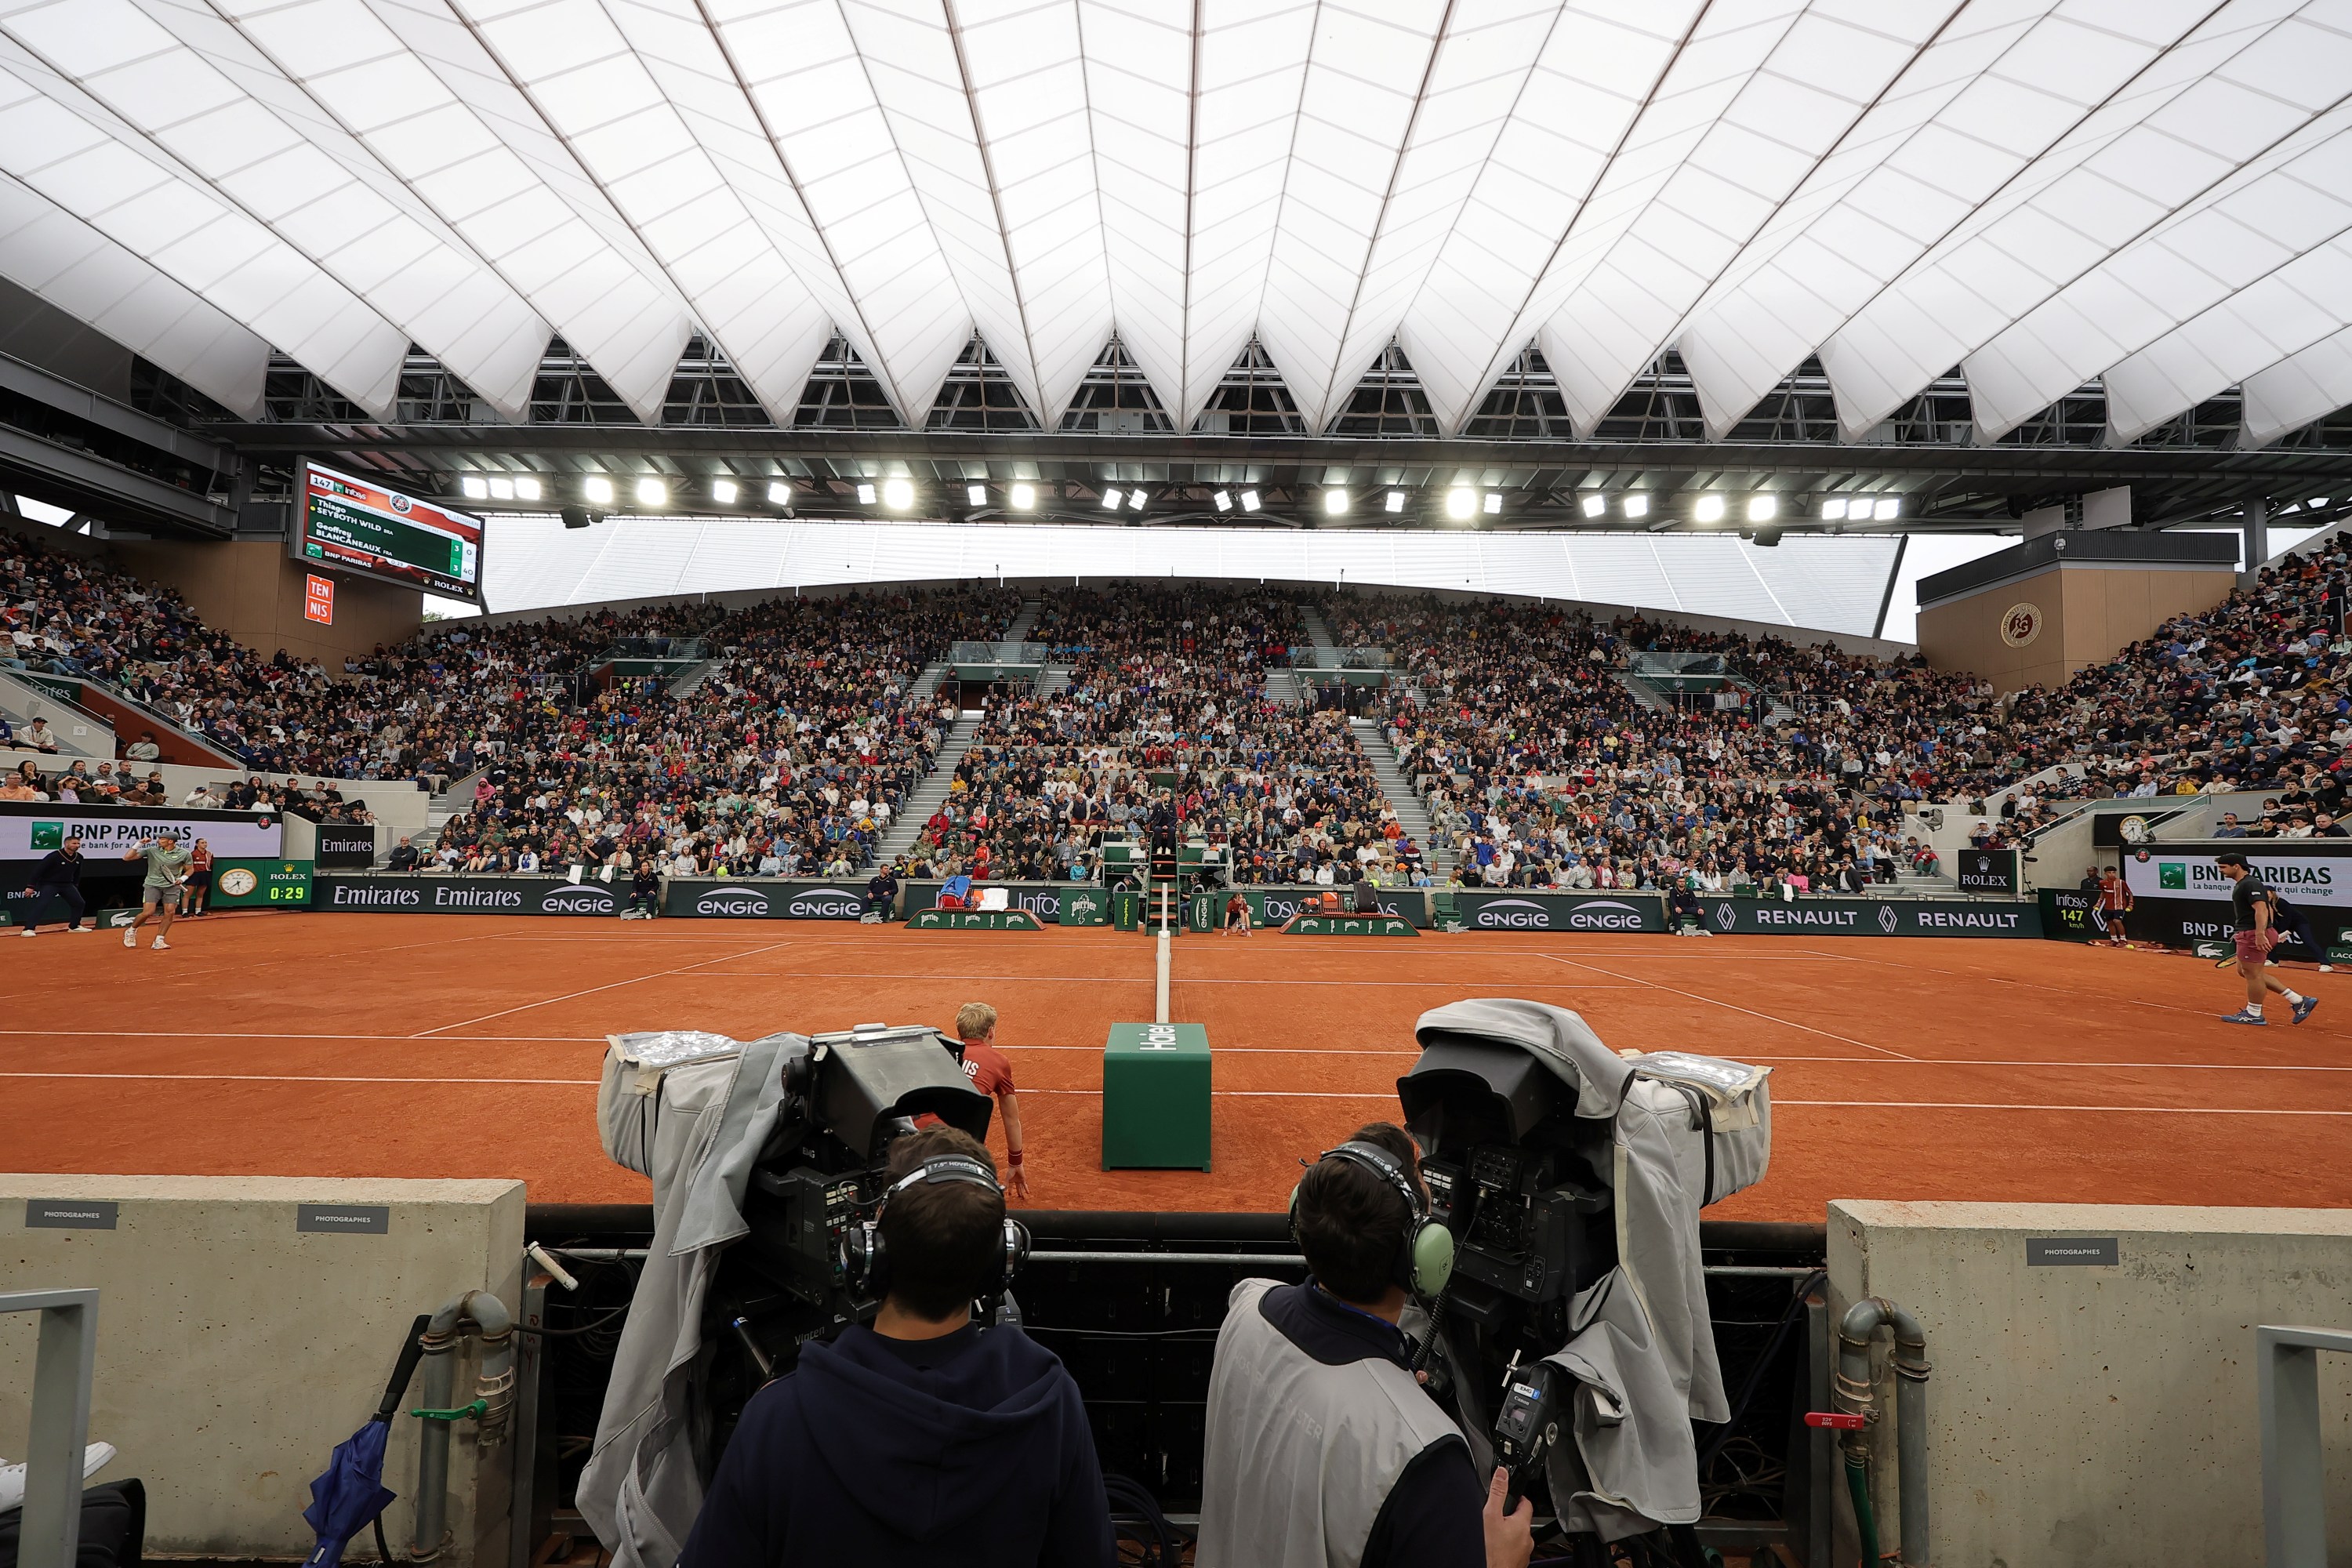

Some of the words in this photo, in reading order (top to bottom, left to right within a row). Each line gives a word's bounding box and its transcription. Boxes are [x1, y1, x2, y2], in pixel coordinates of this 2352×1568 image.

[314, 477, 331, 488] 147
[345, 486, 366, 500] Infosys
[317, 499, 347, 514] Thiago
[317, 506, 358, 524] SEYBOTH
[358, 519, 382, 532] WILD
[351, 502, 366, 510] TOUR
[367, 506, 412, 524] QUALIFICATIONS
[412, 521, 430, 531] SIMPLE
[432, 528, 459, 539] MESSIEURS
[454, 514, 478, 526] LENGLEN
[316, 521, 352, 539] Geoffrey
[316, 529, 381, 554] BLANCANEAUX
[325, 550, 340, 559] BNP
[341, 555, 372, 568] PARIBAS
[463, 567, 474, 575] 40
[310, 581, 329, 597] TEN
[434, 579, 463, 593] ROLEX
[310, 601, 328, 618] NIS
[71, 824, 112, 840] BNP
[111, 841, 123, 851] for
[322, 838, 372, 853] Emirates
[1962, 874, 2008, 887] ROLEX
[2252, 866, 2332, 885] ARIBAS
[270, 887, 304, 900] 0:29
[333, 885, 420, 906] Emirates
[435, 887, 521, 907] Emirates
[2203, 883, 2231, 892] banque
[2285, 886, 2298, 895] qui
[2301, 887, 2333, 896] change
[2056, 894, 2089, 909] Infosys
[1756, 909, 1858, 926] RENAULT
[1918, 912, 2019, 928] RENAULT
[2060, 909, 2084, 922] 147
[2183, 922, 2219, 938] BNP
[44, 1210, 100, 1220] PHOTOGRAPHES
[315, 1215, 371, 1224] PHOTOGRAPHES
[1514, 1396, 1530, 1406] Canon
